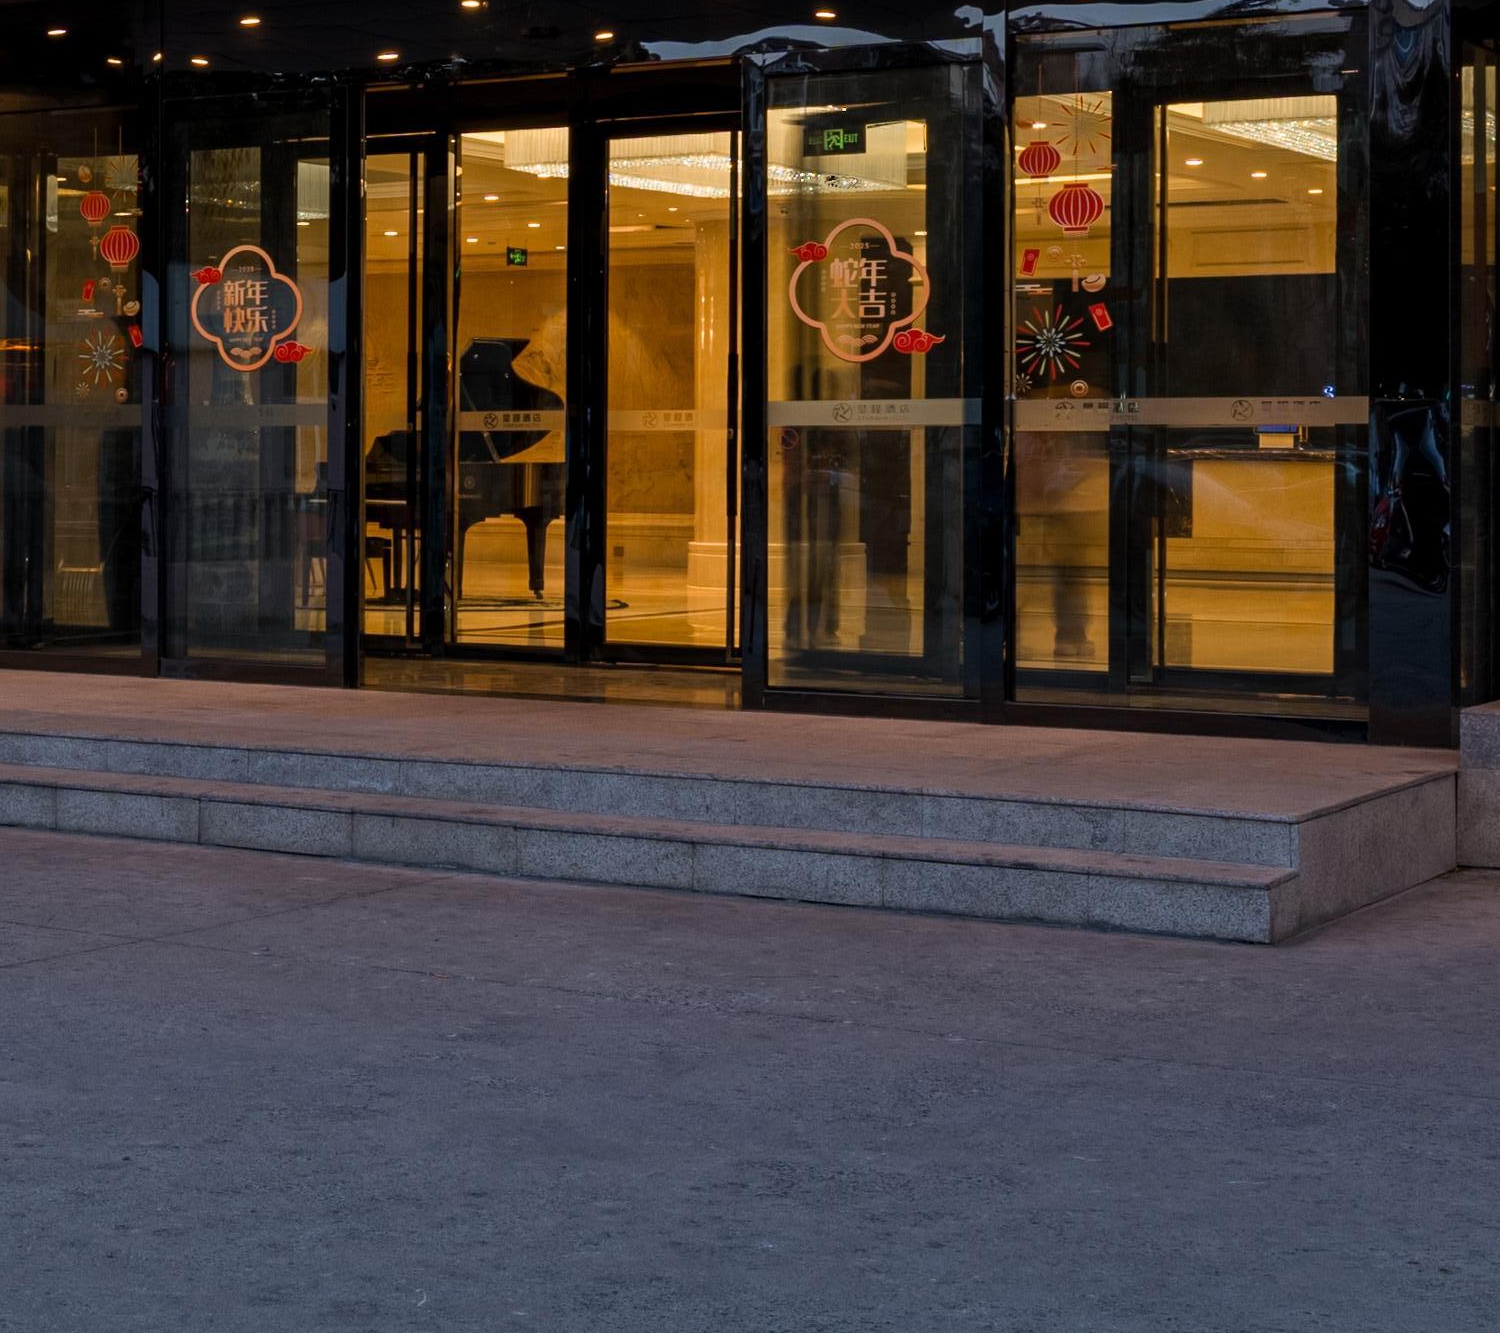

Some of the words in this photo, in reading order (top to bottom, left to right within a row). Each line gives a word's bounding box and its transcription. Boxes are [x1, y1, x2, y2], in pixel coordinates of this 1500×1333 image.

[829, 257, 888, 289] 蛇年
[222, 279, 269, 307] 新年
[830, 288, 887, 319] 大吉
[222, 306, 269, 334] 快乐
